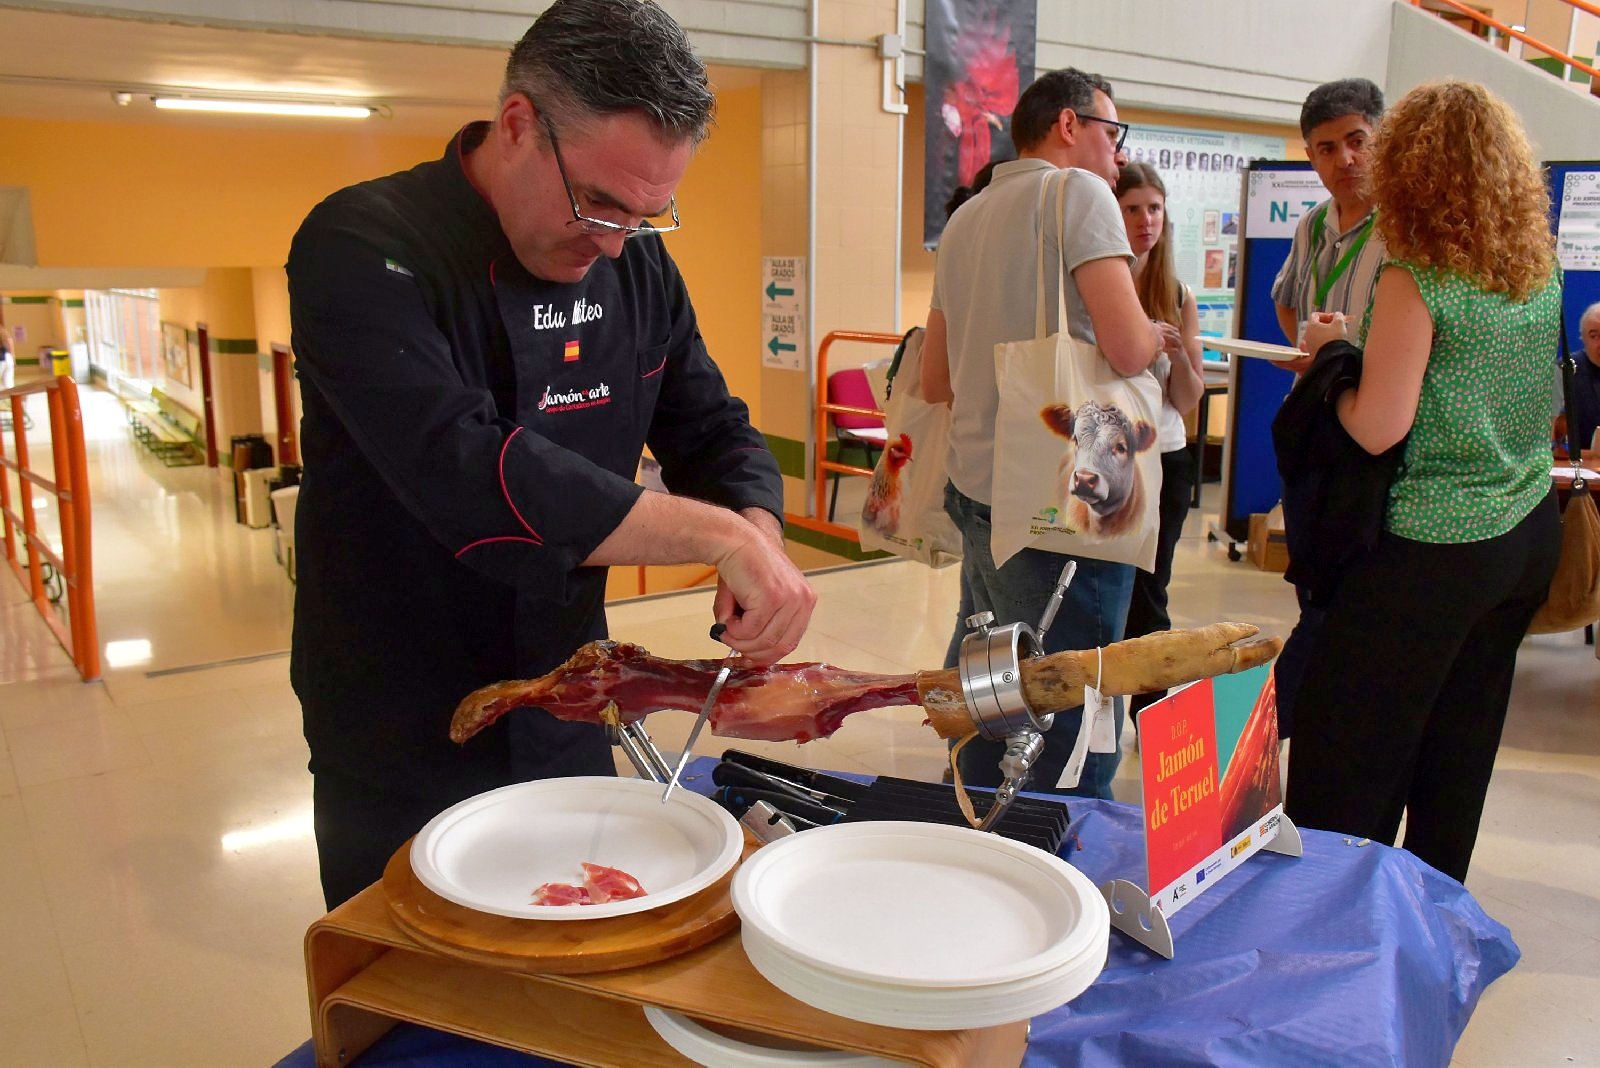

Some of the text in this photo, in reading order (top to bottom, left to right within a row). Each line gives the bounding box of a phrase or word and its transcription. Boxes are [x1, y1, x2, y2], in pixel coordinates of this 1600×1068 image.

[771, 259, 795, 268] AULA DE
[771, 268, 796, 278] GRADOS
[533, 297, 603, 330] Edu Mteo
[771, 315, 795, 325] AULA DE
[771, 324, 796, 335] GRADOS
[538, 385, 586, 410] Jamón
[588, 382, 610, 399] arte
[1156, 734, 1205, 783] Jamón
[1151, 764, 1215, 831] de Teruel
